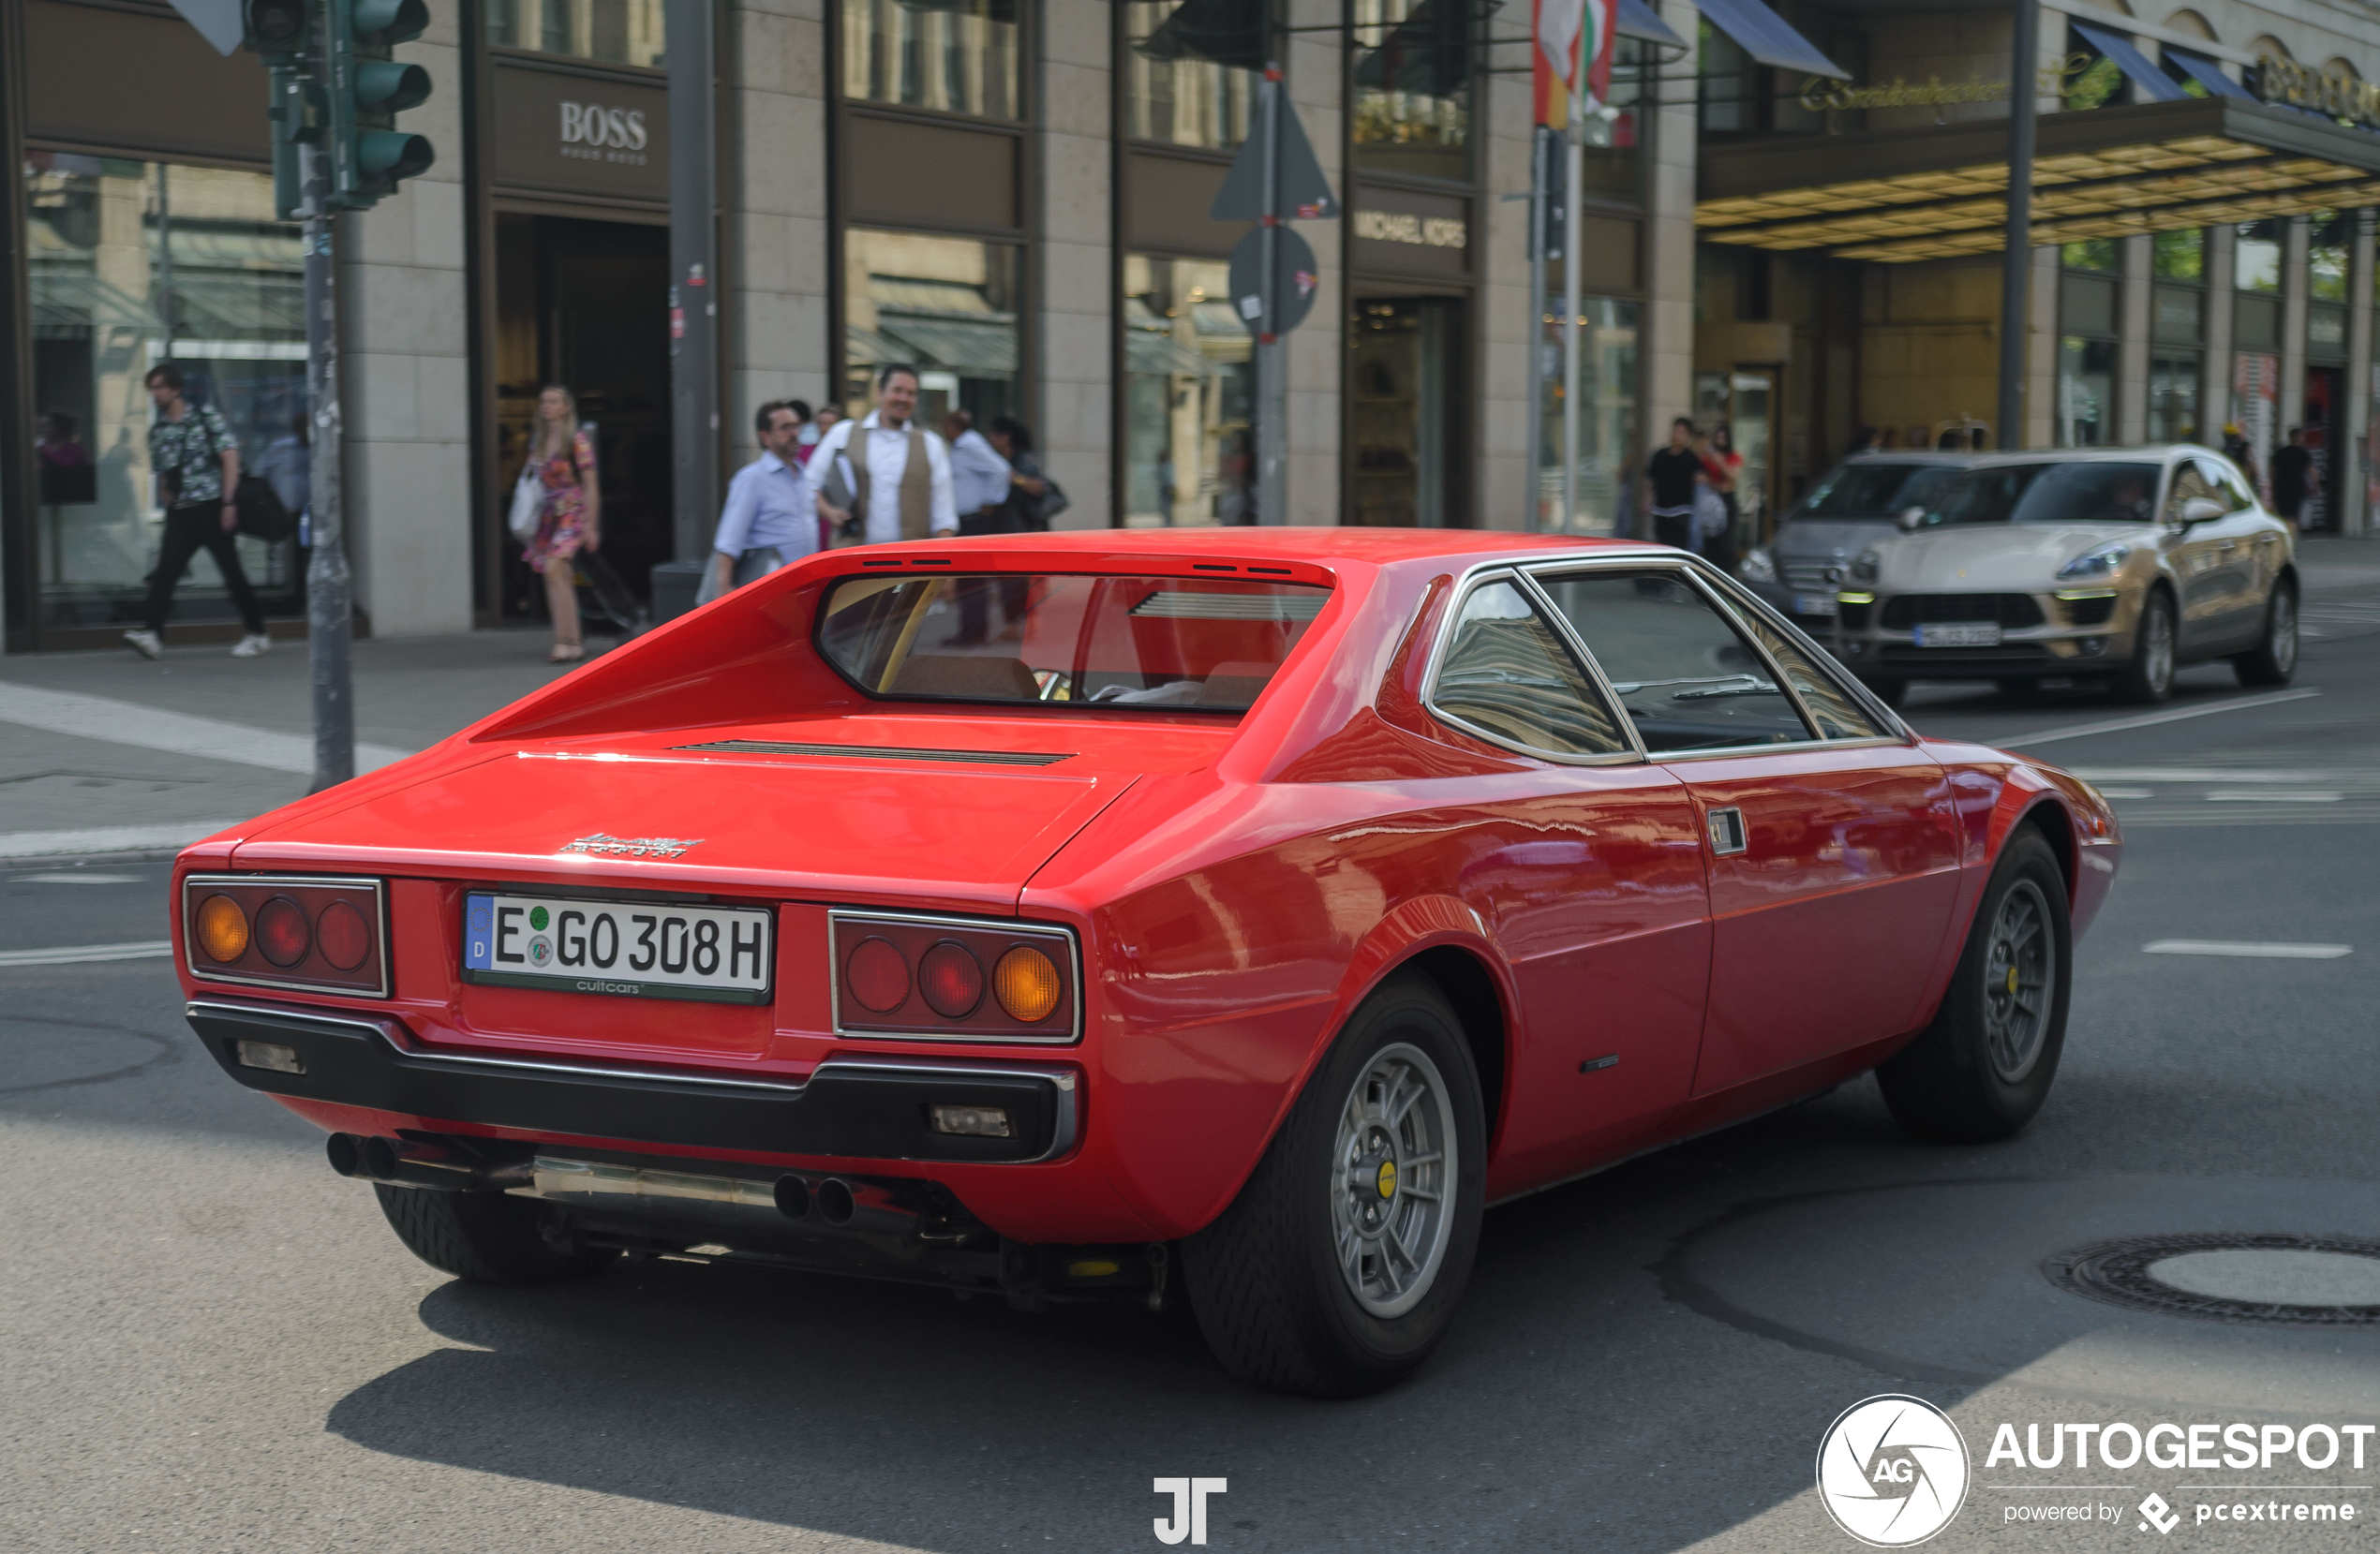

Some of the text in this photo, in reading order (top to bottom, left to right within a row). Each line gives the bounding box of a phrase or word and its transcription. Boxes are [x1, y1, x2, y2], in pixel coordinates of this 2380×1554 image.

[559, 101, 647, 151] BOSS
[473, 941, 485, 958] D
[496, 906, 525, 964] E
[576, 980, 639, 995] cultcars
